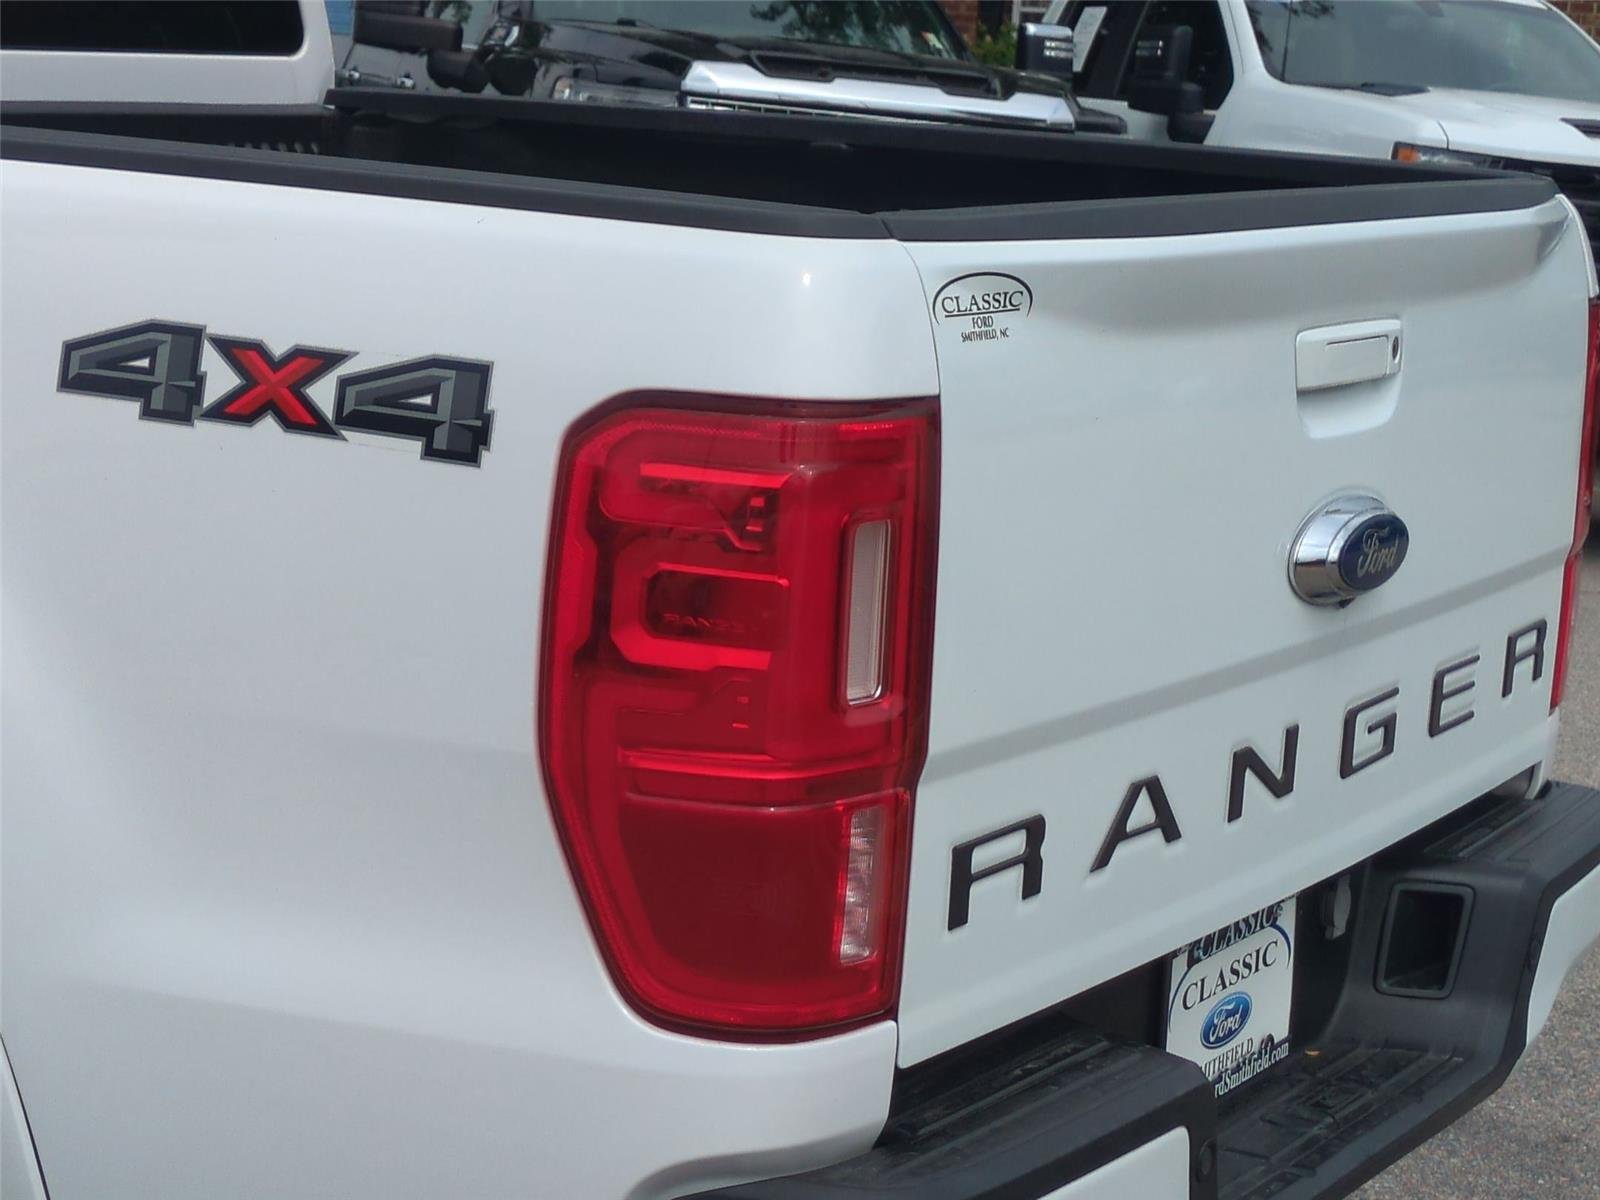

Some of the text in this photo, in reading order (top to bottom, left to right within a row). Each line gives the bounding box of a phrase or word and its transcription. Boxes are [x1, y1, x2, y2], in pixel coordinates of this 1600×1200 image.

[941, 291, 1024, 313] CLASSIC
[972, 316, 994, 329] FORD
[961, 328, 1010, 342] SMITHFIELD, NC
[1357, 527, 1398, 577] Ford
[947, 619, 1547, 931] RANGER
[1182, 939, 1279, 1011] CLASSIC
[1210, 1002, 1243, 1042] Ford
[1202, 1037, 1254, 1079] ITHFIELD
[1214, 1042, 1289, 1098] rdSmithfield.com
